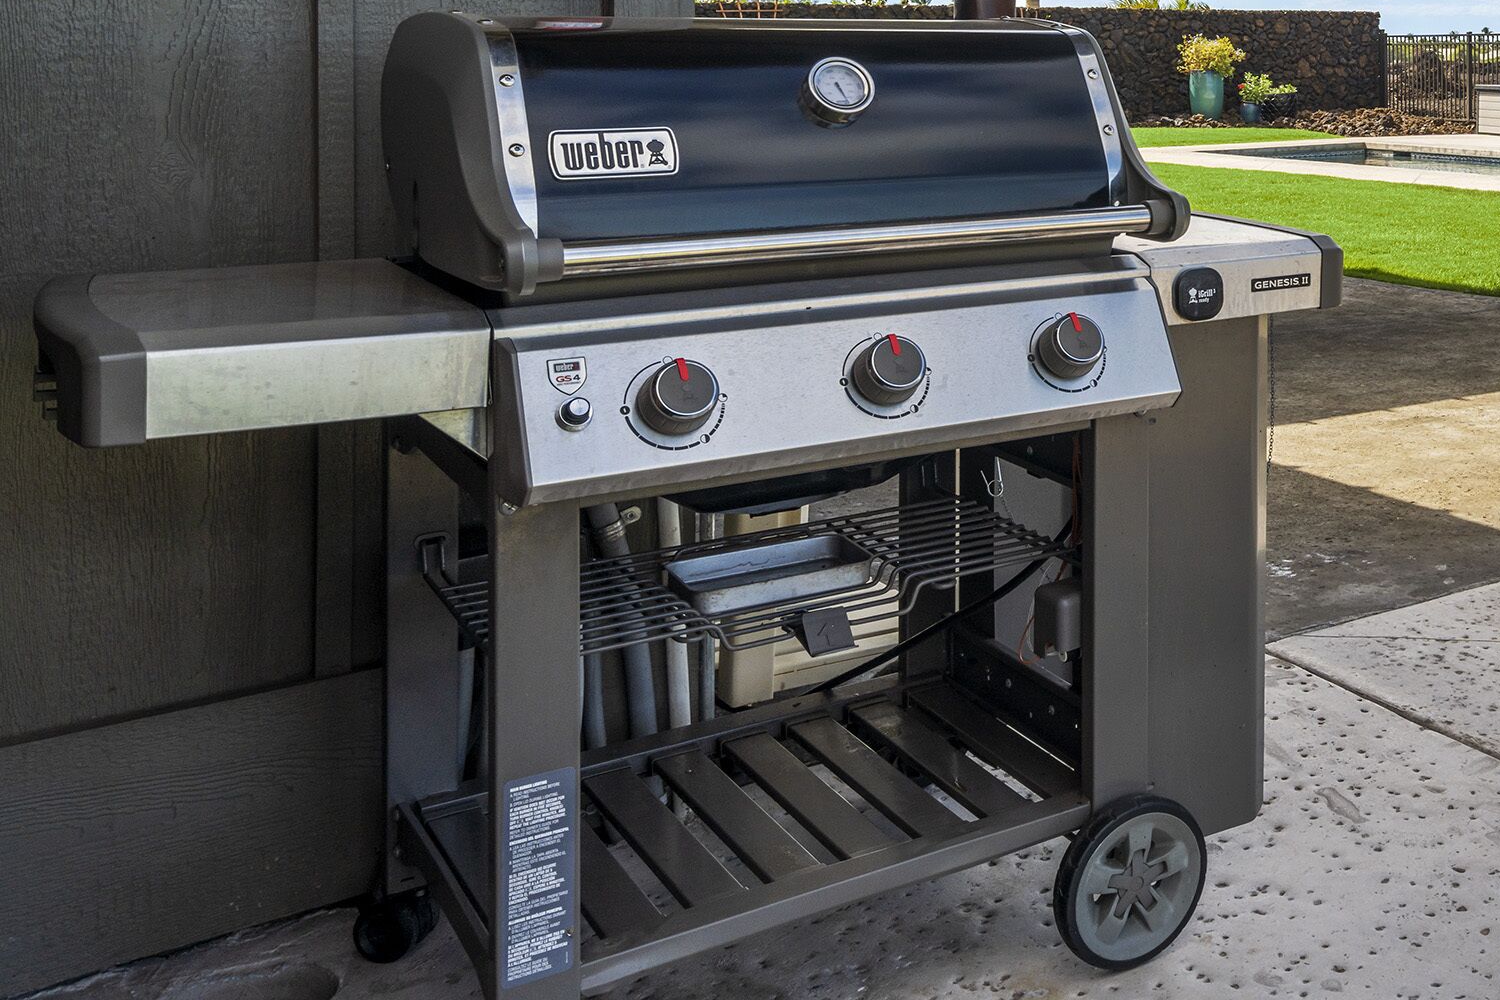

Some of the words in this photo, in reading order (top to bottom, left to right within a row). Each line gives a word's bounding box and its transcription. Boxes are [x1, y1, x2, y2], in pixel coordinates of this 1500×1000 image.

[560, 132, 644, 170] weber
[1254, 277, 1299, 290] GENESIS
[1301, 276, 1309, 285] II
[555, 362, 574, 372] weber
